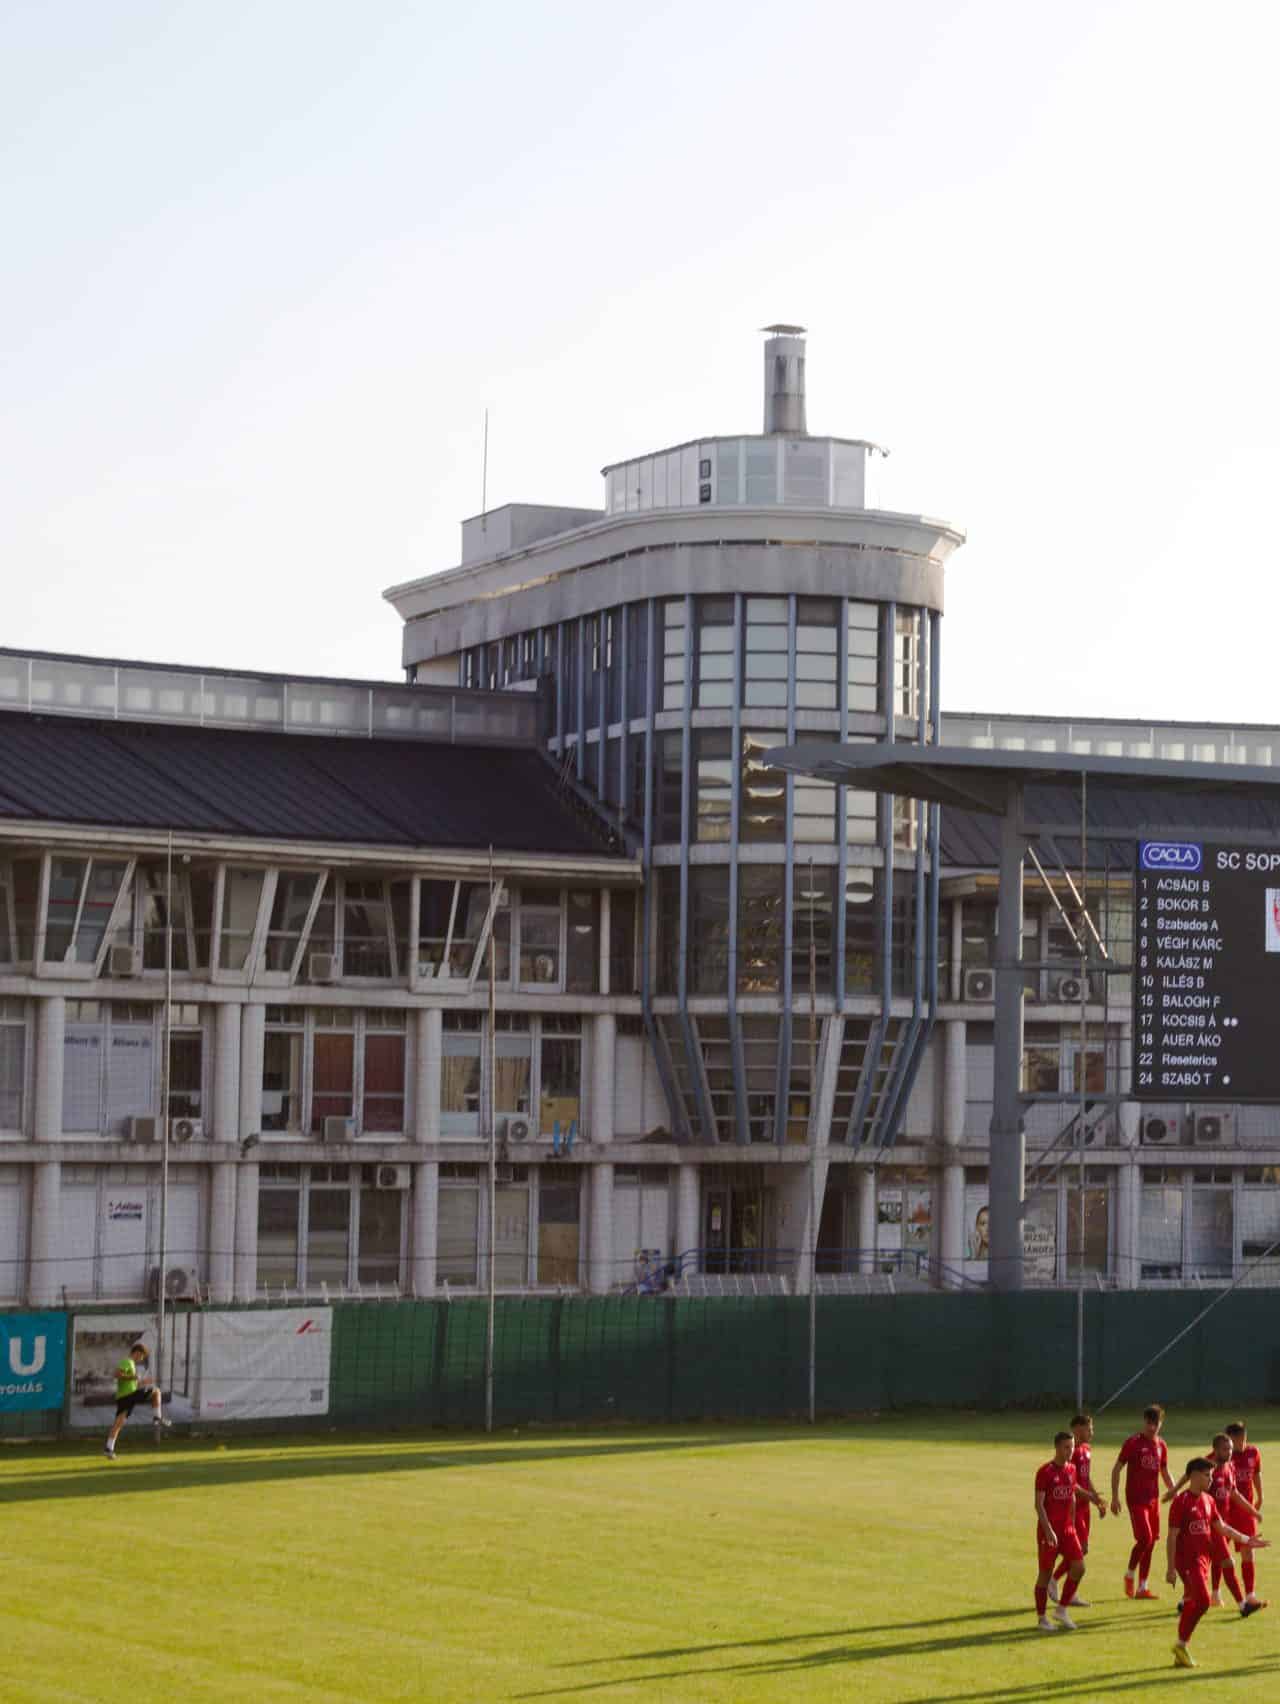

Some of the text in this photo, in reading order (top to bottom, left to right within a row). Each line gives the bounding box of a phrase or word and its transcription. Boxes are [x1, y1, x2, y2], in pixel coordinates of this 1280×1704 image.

[1216, 851, 1241, 869] SC
[1141, 878, 1147, 888] 1
[1202, 880, 1211, 892] B
[1140, 897, 1210, 912] 2 BOKOR B
[1140, 917, 1148, 928] 4
[1156, 935, 1190, 949] VÉGH
[1156, 955, 1201, 969] KALÁSZ
[1202, 957, 1213, 969] M
[1141, 975, 1154, 987] 10
[1141, 994, 1154, 1006] 15
[1162, 994, 1211, 1008] BALOGH
[1140, 1014, 1153, 1026] 17
[1162, 1014, 1206, 1027] KOCSIS
[1141, 1033, 1153, 1045] 18
[1161, 1033, 1195, 1046] AUER
[1139, 1053, 1153, 1065] 22
[1139, 1071, 1212, 1085] 24 SZABÓ T
